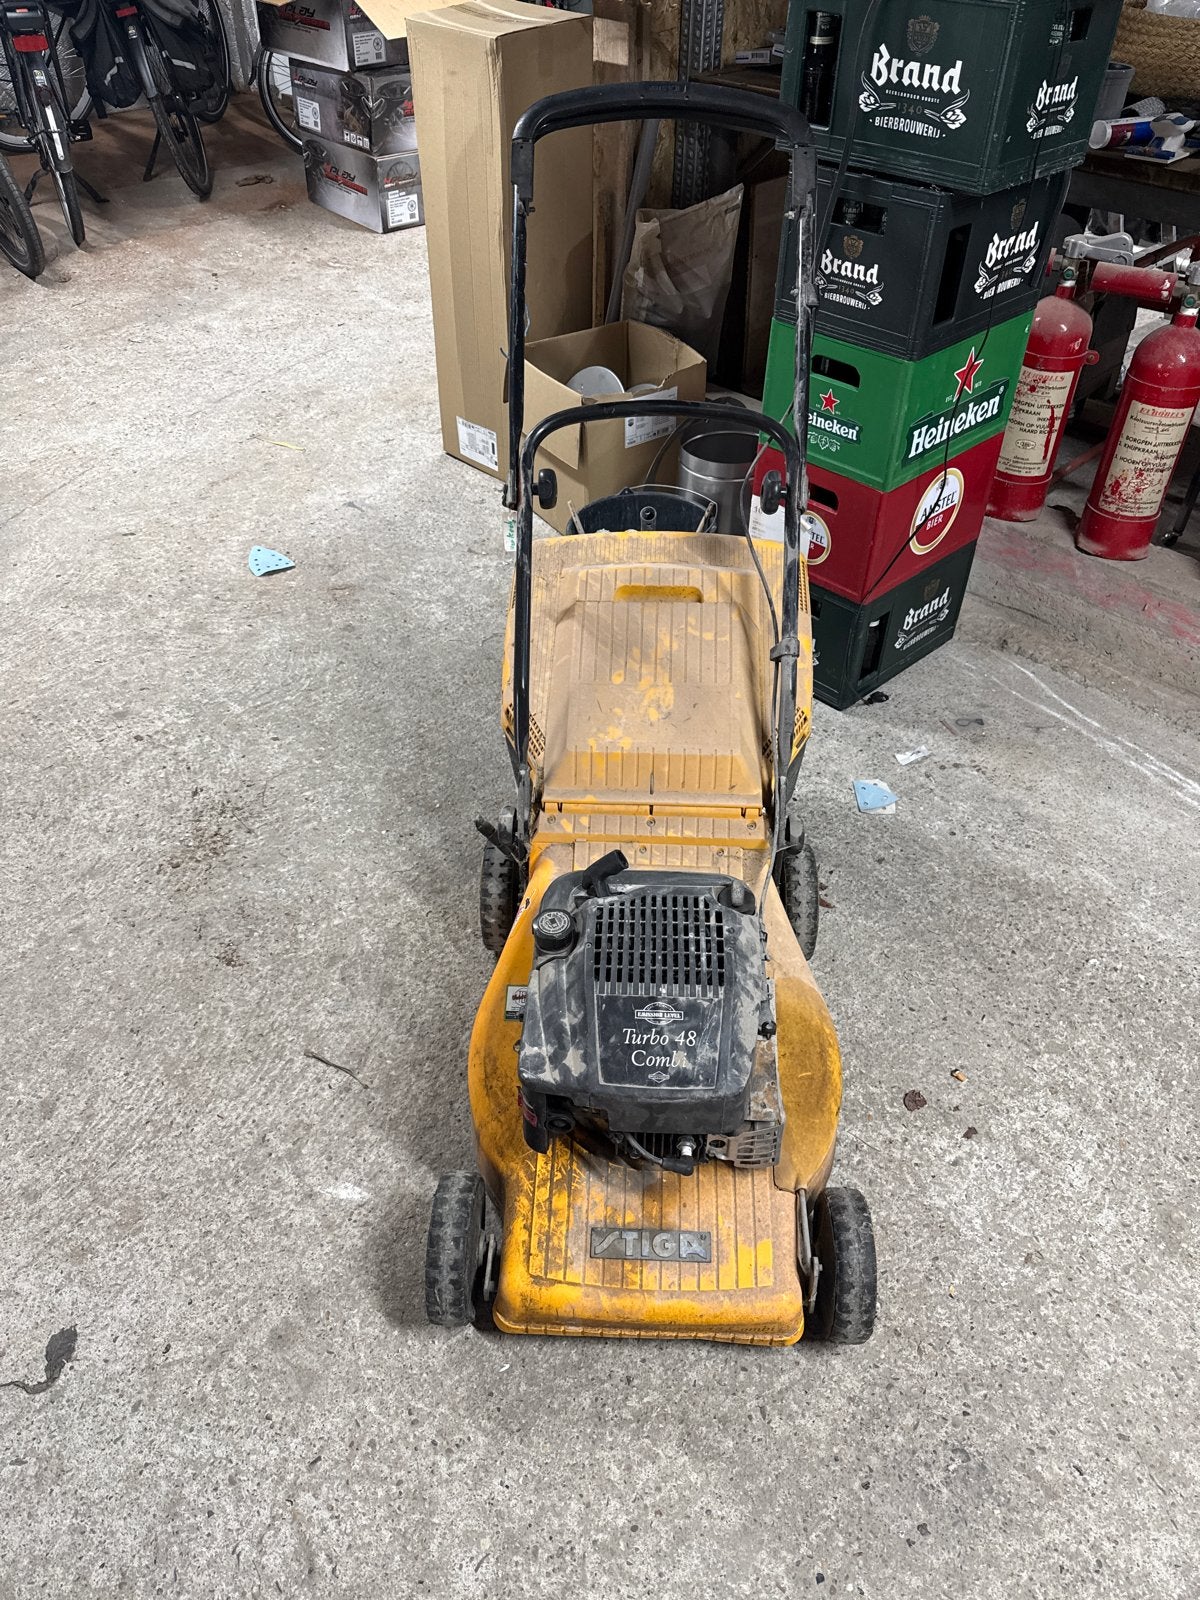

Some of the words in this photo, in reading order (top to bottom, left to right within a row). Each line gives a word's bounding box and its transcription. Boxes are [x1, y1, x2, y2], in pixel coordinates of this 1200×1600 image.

[870, 43, 962, 95] Brand
[1036, 76, 1078, 111] Brand
[875, 117, 940, 138] BIERBROUWERIJ
[820, 249, 878, 285] Brand
[824, 292, 867, 310] BIERBROUWERIJ
[808, 412, 857, 441] eineken
[908, 395, 1001, 458] Heineken
[926, 514, 944, 530] BIER
[903, 587, 950, 630] Brand
[622, 1028, 669, 1046] Turbo
[675, 1030, 697, 1047] 48
[631, 1049, 688, 1068] Combi
[594, 1230, 707, 1259] STIGA
